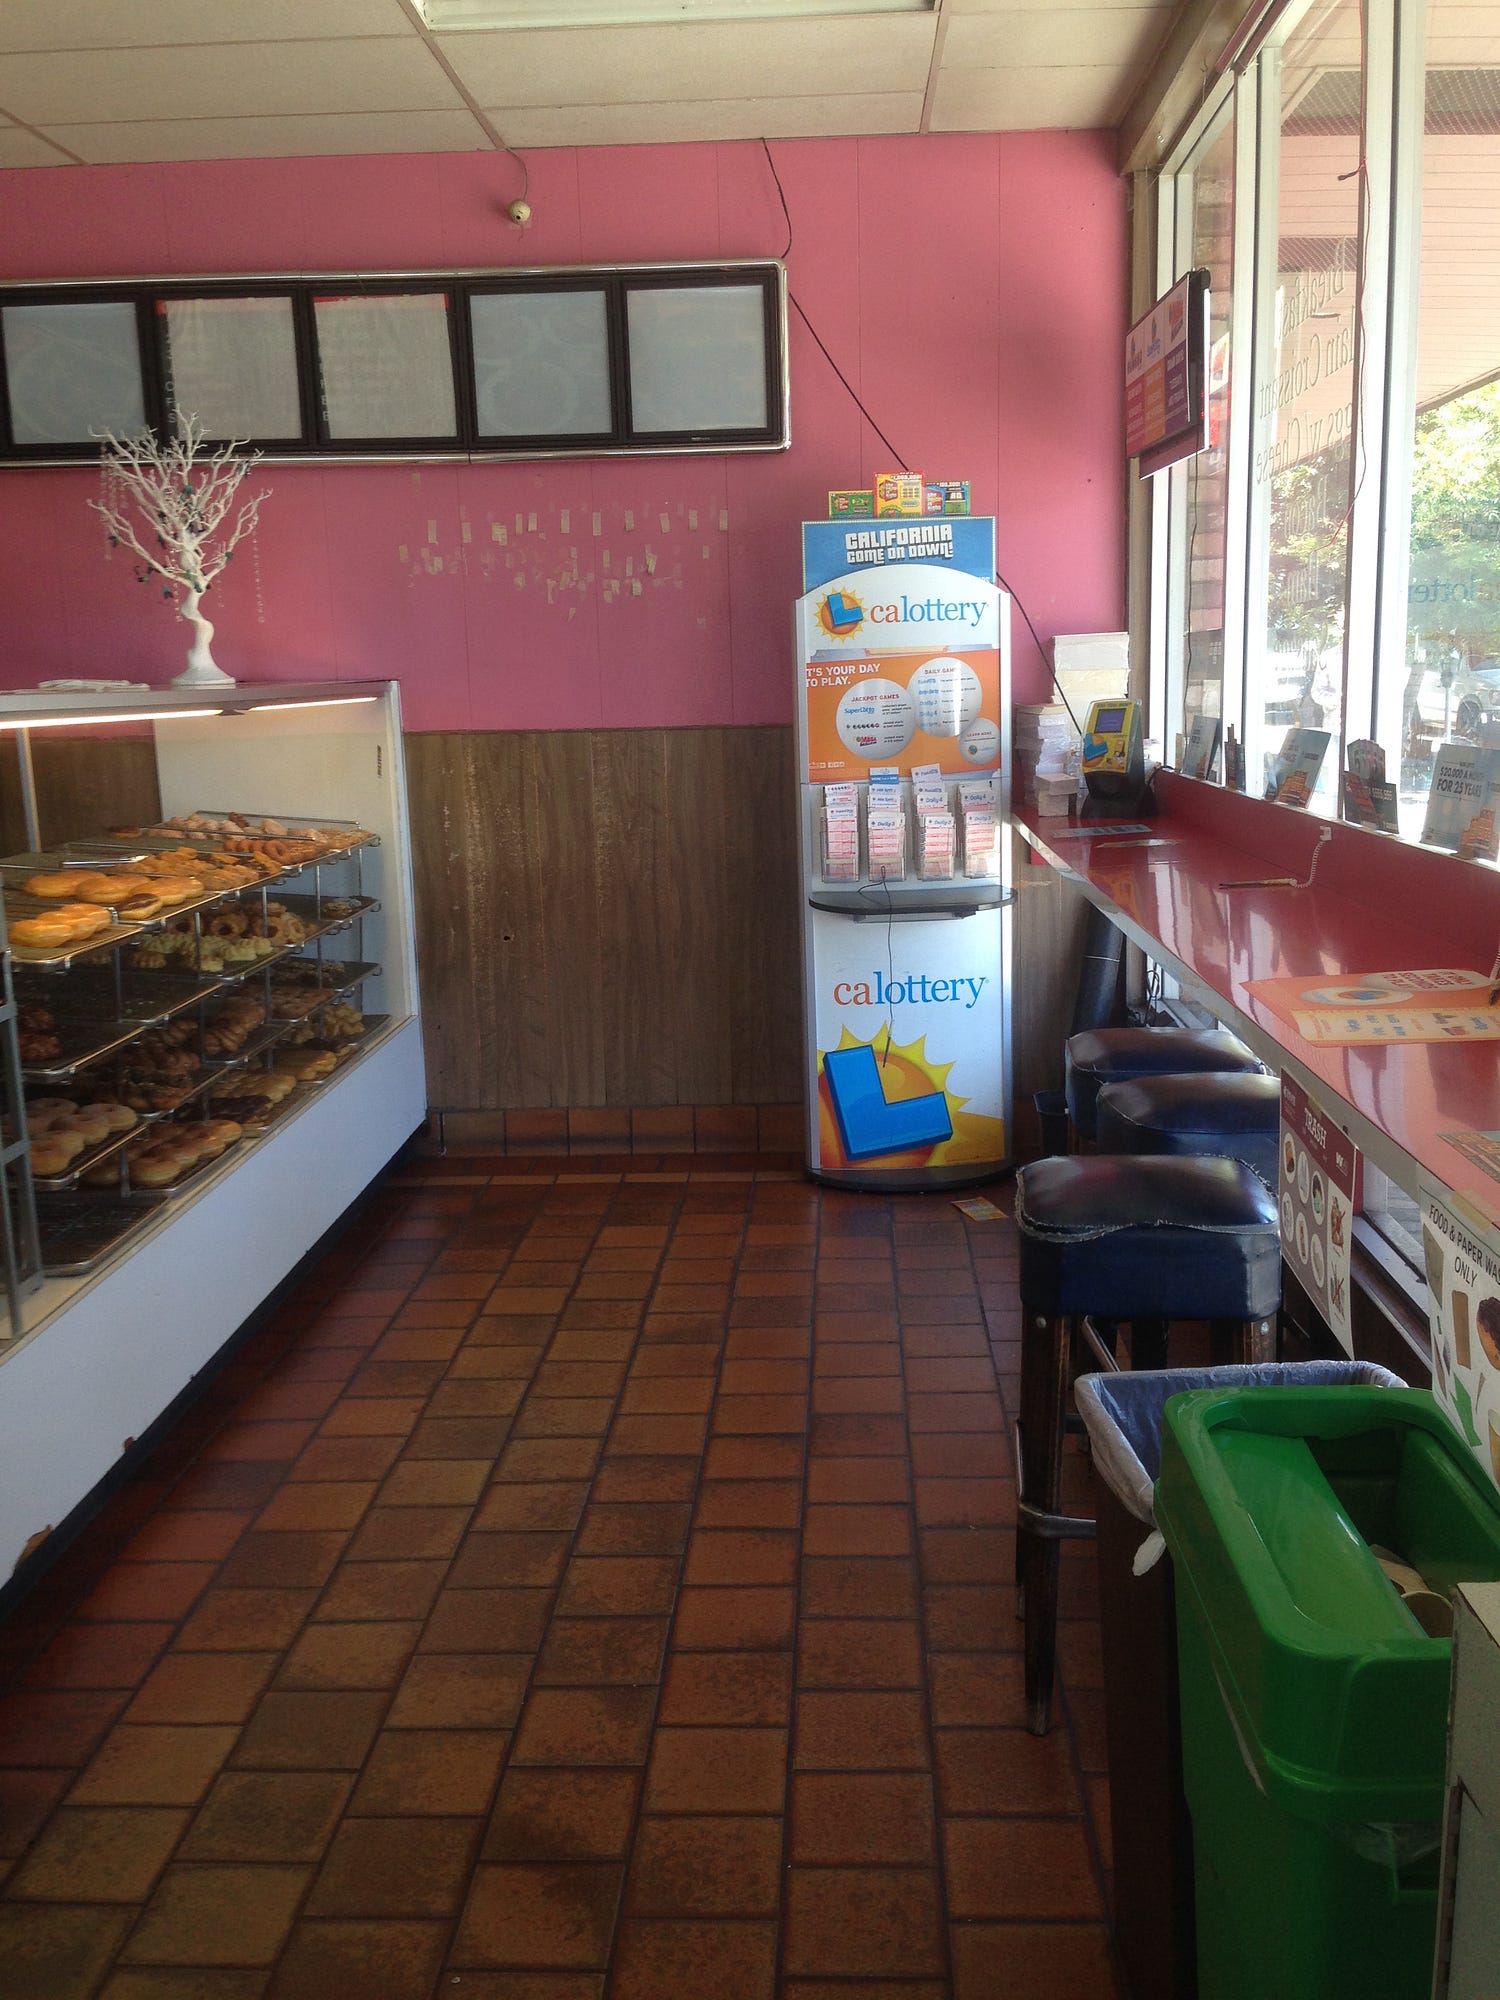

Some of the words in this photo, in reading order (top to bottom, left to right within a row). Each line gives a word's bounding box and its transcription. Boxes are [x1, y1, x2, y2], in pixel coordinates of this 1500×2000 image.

[845, 524, 953, 550] CALIFORNIA
[846, 548, 885, 565] COME
[888, 547, 906, 561] ON
[909, 542, 955, 560] DOWN!
[870, 596, 988, 627] calottery
[806, 667, 823, 677] T'S
[826, 665, 856, 676] YOUR
[859, 664, 881, 674] DAY
[821, 676, 851, 687] PLAY.
[851, 695, 878, 703] JACKPOT
[1437, 779, 1454, 793] FOR
[1454, 781, 1464, 795] 25
[833, 971, 987, 1009] calottery
[1304, 1107, 1327, 1150] TRASH
[1429, 1204, 1449, 1235] FOOD
[1449, 1225, 1456, 1243] &
[1457, 1232, 1483, 1268] PAPER
[1454, 1256, 1478, 1288] ONLY
